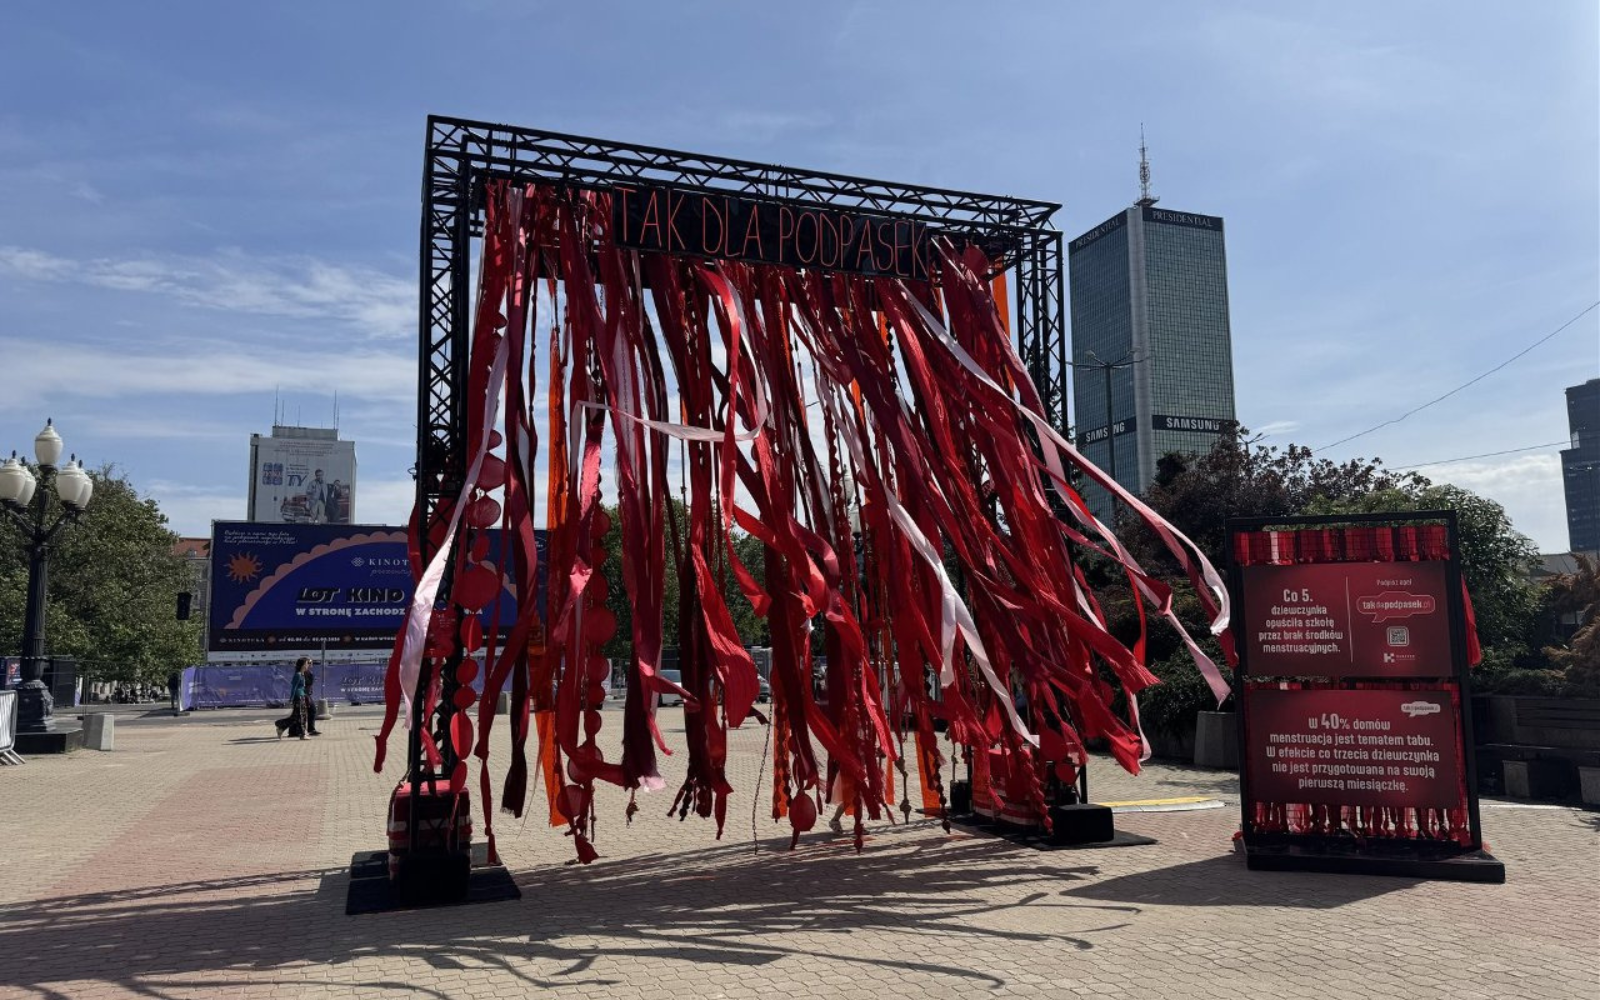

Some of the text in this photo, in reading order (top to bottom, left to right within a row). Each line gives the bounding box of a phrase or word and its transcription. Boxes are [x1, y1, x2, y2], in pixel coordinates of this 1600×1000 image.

[1153, 211, 1213, 227] PRESIDENTIAL
[614, 187, 929, 279] TAK DLA PODPASEK
[1075, 217, 1120, 249] PRESIDENTIAL
[1166, 417, 1220, 431] SAMSUNG
[1086, 422, 1125, 442] SAMSNG
[369, 558, 409, 566] KINOT
[347, 588, 405, 604] KINO
[1283, 588, 1313, 602] Co 5.
[296, 608, 406, 618] W STRONĘ ZACHODZ
[1271, 605, 1327, 616] dziewczynka
[1266, 617, 1334, 629] opuściła szkołę
[1259, 629, 1343, 642] przez brak środków
[1263, 642, 1340, 654] menstruacyjnych.
[1321, 713, 1350, 729] 40%
[1353, 718, 1391, 730] domów
[1269, 733, 1434, 746] menstruacja jest tematem tabu.
[1266, 746, 1439, 763] W efekcie co trzecia dziewczynka
[1272, 761, 1435, 778] nie jest przygotowana na swoją
[1298, 776, 1409, 793] pierwszą miesiączkę.
